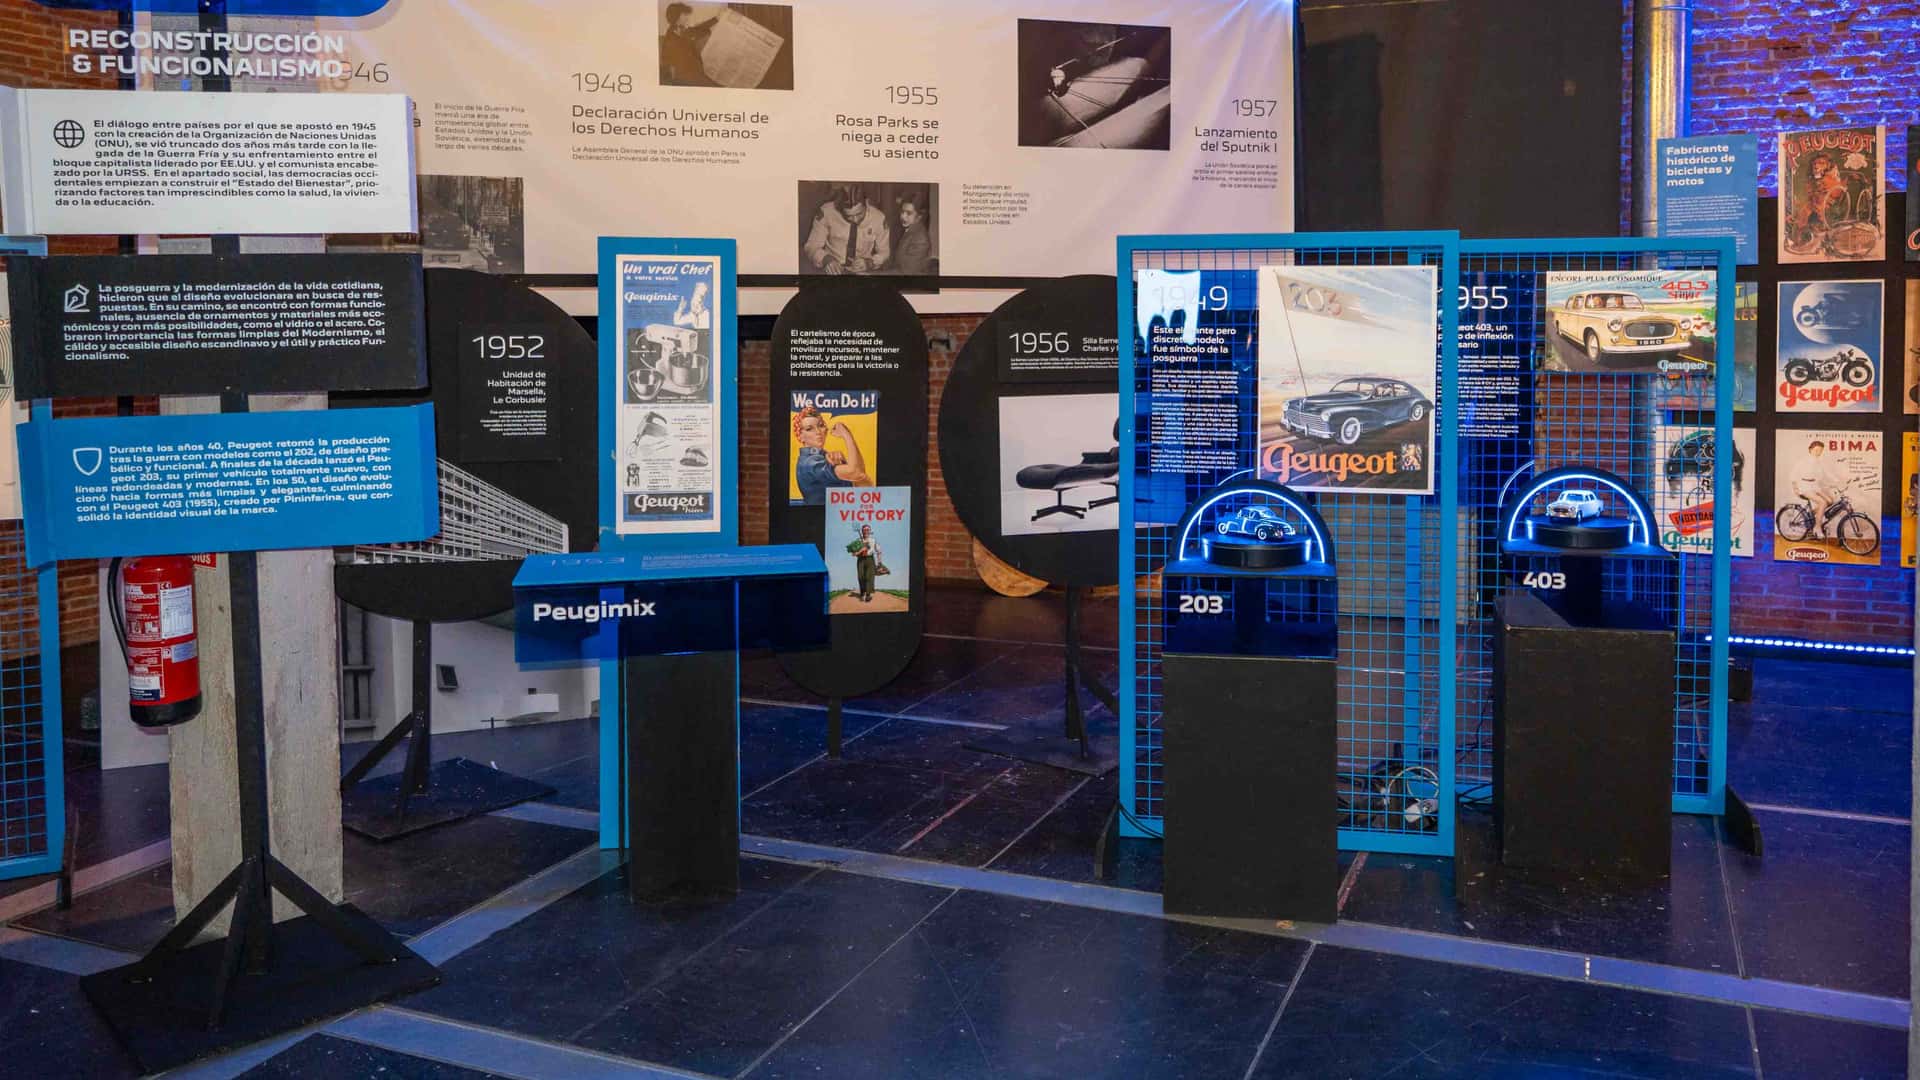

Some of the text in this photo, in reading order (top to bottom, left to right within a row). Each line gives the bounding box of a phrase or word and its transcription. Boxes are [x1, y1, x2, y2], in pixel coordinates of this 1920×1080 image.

[69, 29, 343, 54] RECONSTRUCCIÓN
[73, 55, 343, 78] & FUNCIONALISMO
[336, 61, 389, 83] 946
[571, 72, 633, 94] 1948
[885, 85, 938, 105] 1955
[572, 104, 769, 124] Declaración Universal de
[1232, 99, 1277, 117] 1957
[94, 120, 104, 128] El
[107, 120, 150, 130] diálogo
[184, 121, 220, 130] países
[223, 123, 241, 131] por
[244, 121, 254, 129] el
[257, 123, 277, 131] que
[296, 122, 332, 131] apostó
[352, 122, 376, 130] 1945
[835, 114, 939, 129] Rosa Parks se
[572, 121, 760, 139] los Derechos Humanos
[1194, 126, 1278, 139] Lanzamiento
[841, 130, 939, 145] niega a ceder
[1200, 140, 1219, 152] del
[1222, 141, 1271, 154] Sputnik
[1666, 144, 1729, 156] Fabricante
[1782, 130, 1876, 168] PEUGEOT
[863, 148, 939, 160] su asiento
[1666, 154, 1736, 166] histórico de
[1666, 166, 1732, 176] bicicletas y
[1666, 178, 1704, 186] motos
[624, 264, 713, 275] Un vrai Chef
[98, 284, 112, 292] La
[173, 285, 180, 293] y
[182, 283, 193, 291] la
[195, 283, 275, 291] modernización
[278, 282, 292, 290] de
[294, 282, 303, 290] la
[305, 282, 329, 290] vida
[331, 282, 384, 291] cotidiana,
[1661, 280, 1709, 290] 403
[1289, 283, 1342, 316] 203
[1440, 286, 1508, 310] 955
[852, 330, 876, 338] época
[1153, 326, 1236, 336] Este elnte pero
[1475, 324, 1494, 332] 403,
[790, 338, 824, 346] reflejaba
[1153, 336, 1187, 344] discret
[1464, 332, 1476, 340] de
[1477, 332, 1514, 340] inflexión
[472, 336, 544, 358] 1952
[1009, 332, 1070, 354] 1956
[1169, 345, 1206, 353] símbolo
[1153, 355, 1198, 363] posguerra
[790, 362, 836, 370] poblaciones
[508, 388, 546, 396] Marsella,
[1779, 381, 1876, 408] Peugeot
[505, 396, 546, 404] Corbusier
[792, 393, 875, 408] We Can Do It!
[109, 445, 153, 454] Durante
[157, 444, 174, 452] los
[178, 443, 204, 451] años
[227, 440, 272, 450] Peugeot
[276, 438, 315, 448] retomó
[318, 438, 328, 446] la
[332, 436, 390, 446] producción
[1829, 440, 1877, 452] BIMA
[1262, 443, 1398, 484] Peugeot
[634, 494, 704, 512] Peugeot
[831, 492, 882, 504] DIG ON
[840, 510, 905, 522] VICTORY
[1663, 530, 1742, 550] Peugt
[1788, 550, 1826, 560] Peugeot
[1523, 572, 1566, 590] 403
[1179, 594, 1224, 614] 203
[533, 600, 656, 622] Peugimix
